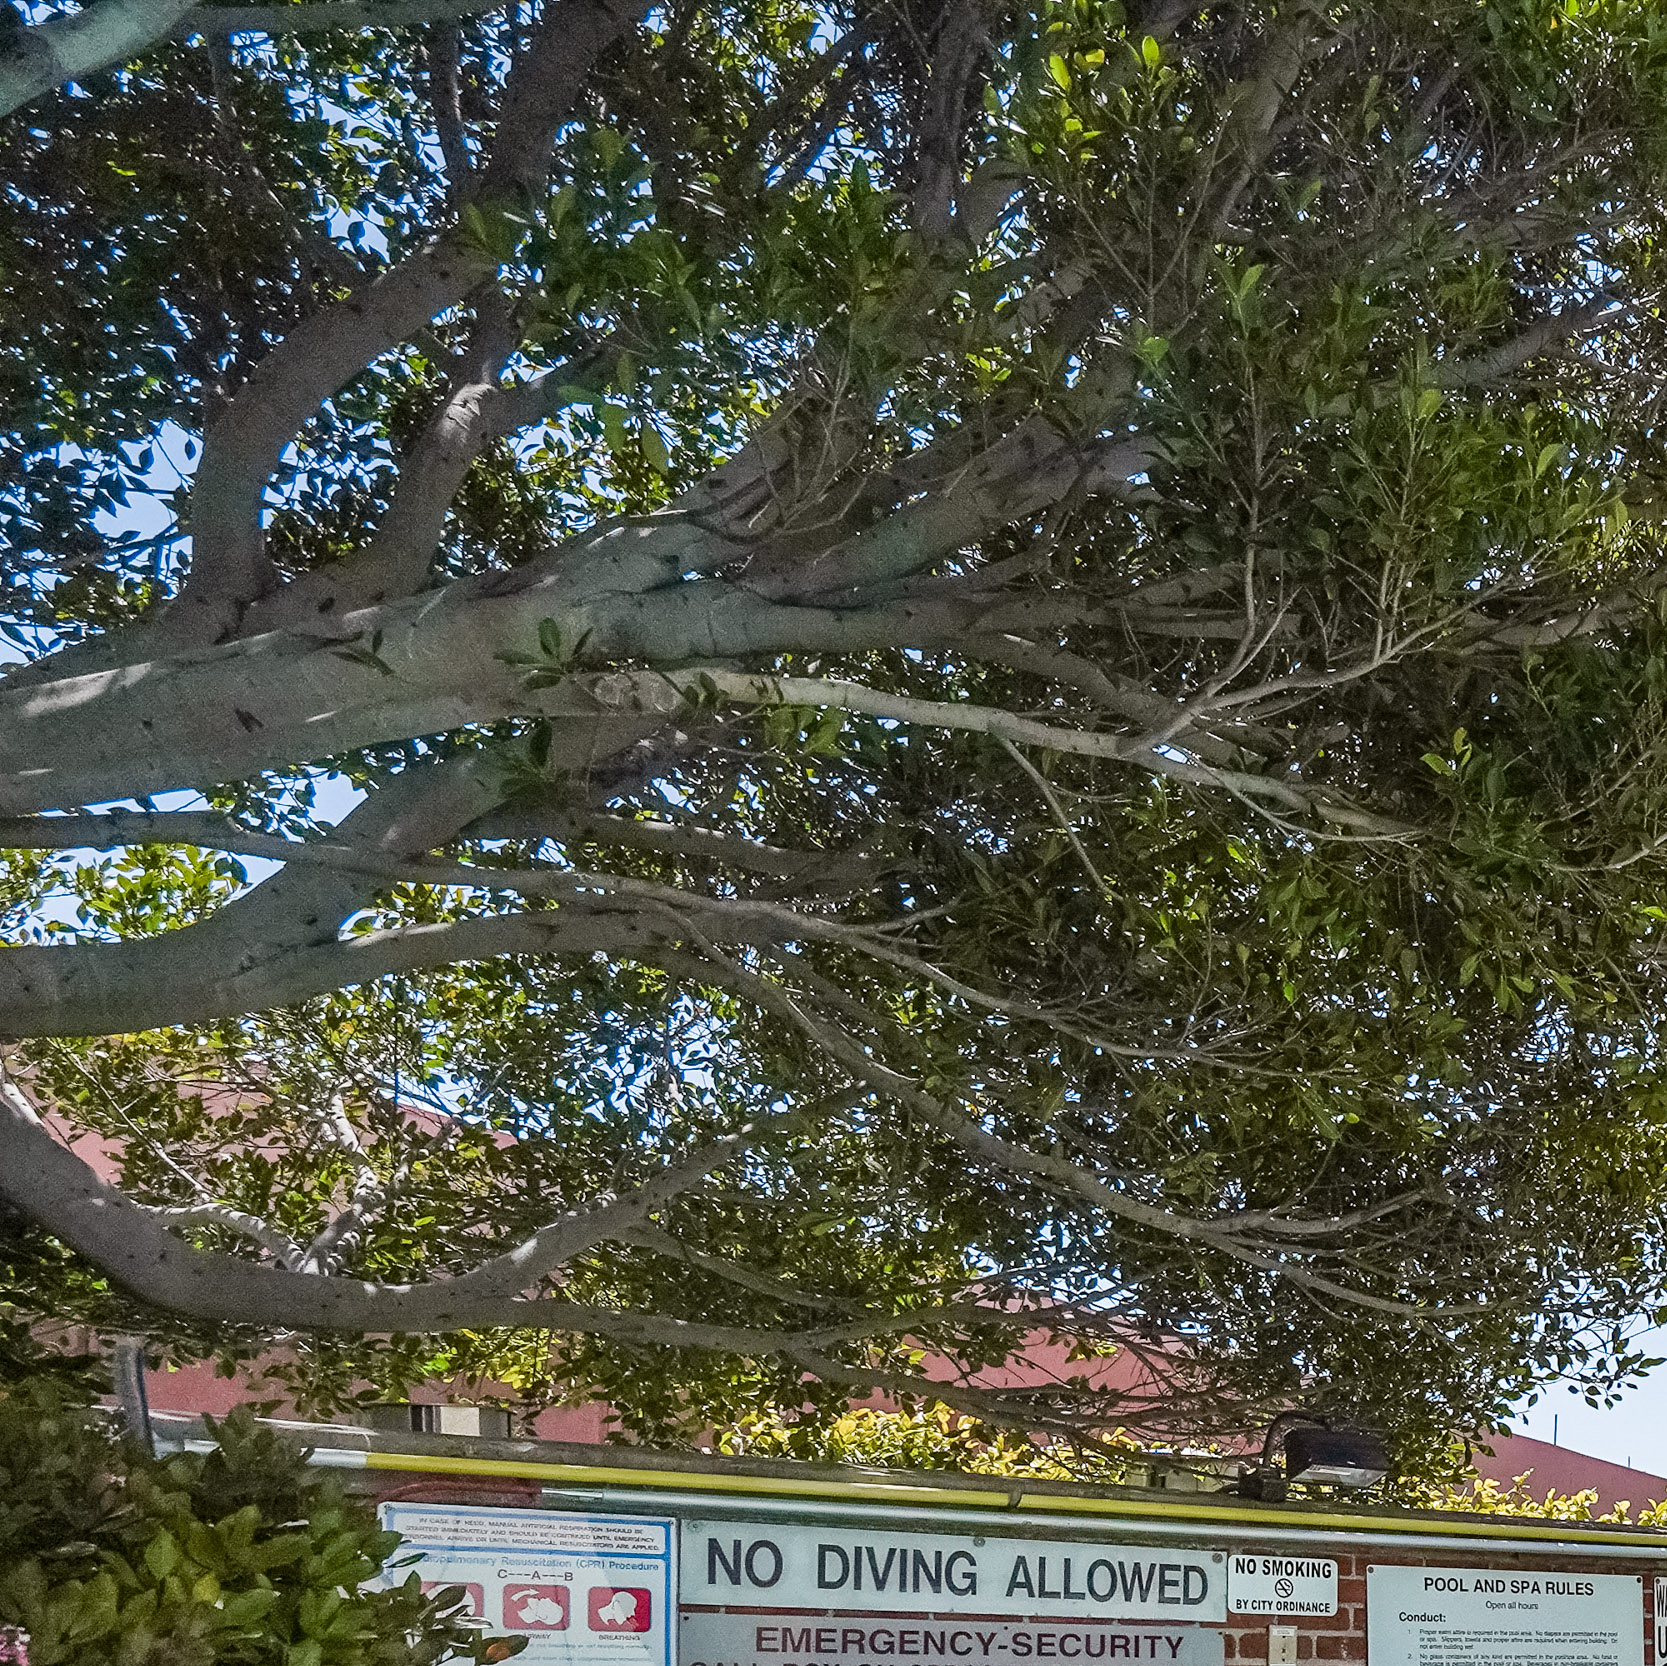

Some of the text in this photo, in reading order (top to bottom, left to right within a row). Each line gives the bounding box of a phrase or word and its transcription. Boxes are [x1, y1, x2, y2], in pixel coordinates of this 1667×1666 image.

[576, 1559, 605, 1570] (CPR)
[609, 1561, 659, 1571] Procedure
[707, 1538, 1208, 1606] NO DIVING ALLOWED
[1235, 1558, 1332, 1579] NO SMOKING
[1424, 1577, 1594, 1596] POOL AND SPA RULES
[1236, 1599, 1331, 1613] BY CITY ORDINANCE
[1486, 1600, 1539, 1610] Open all hours
[1399, 1612, 1446, 1622] Conduct:
[756, 1626, 1184, 1659] EMERGENCY-SECURITY
